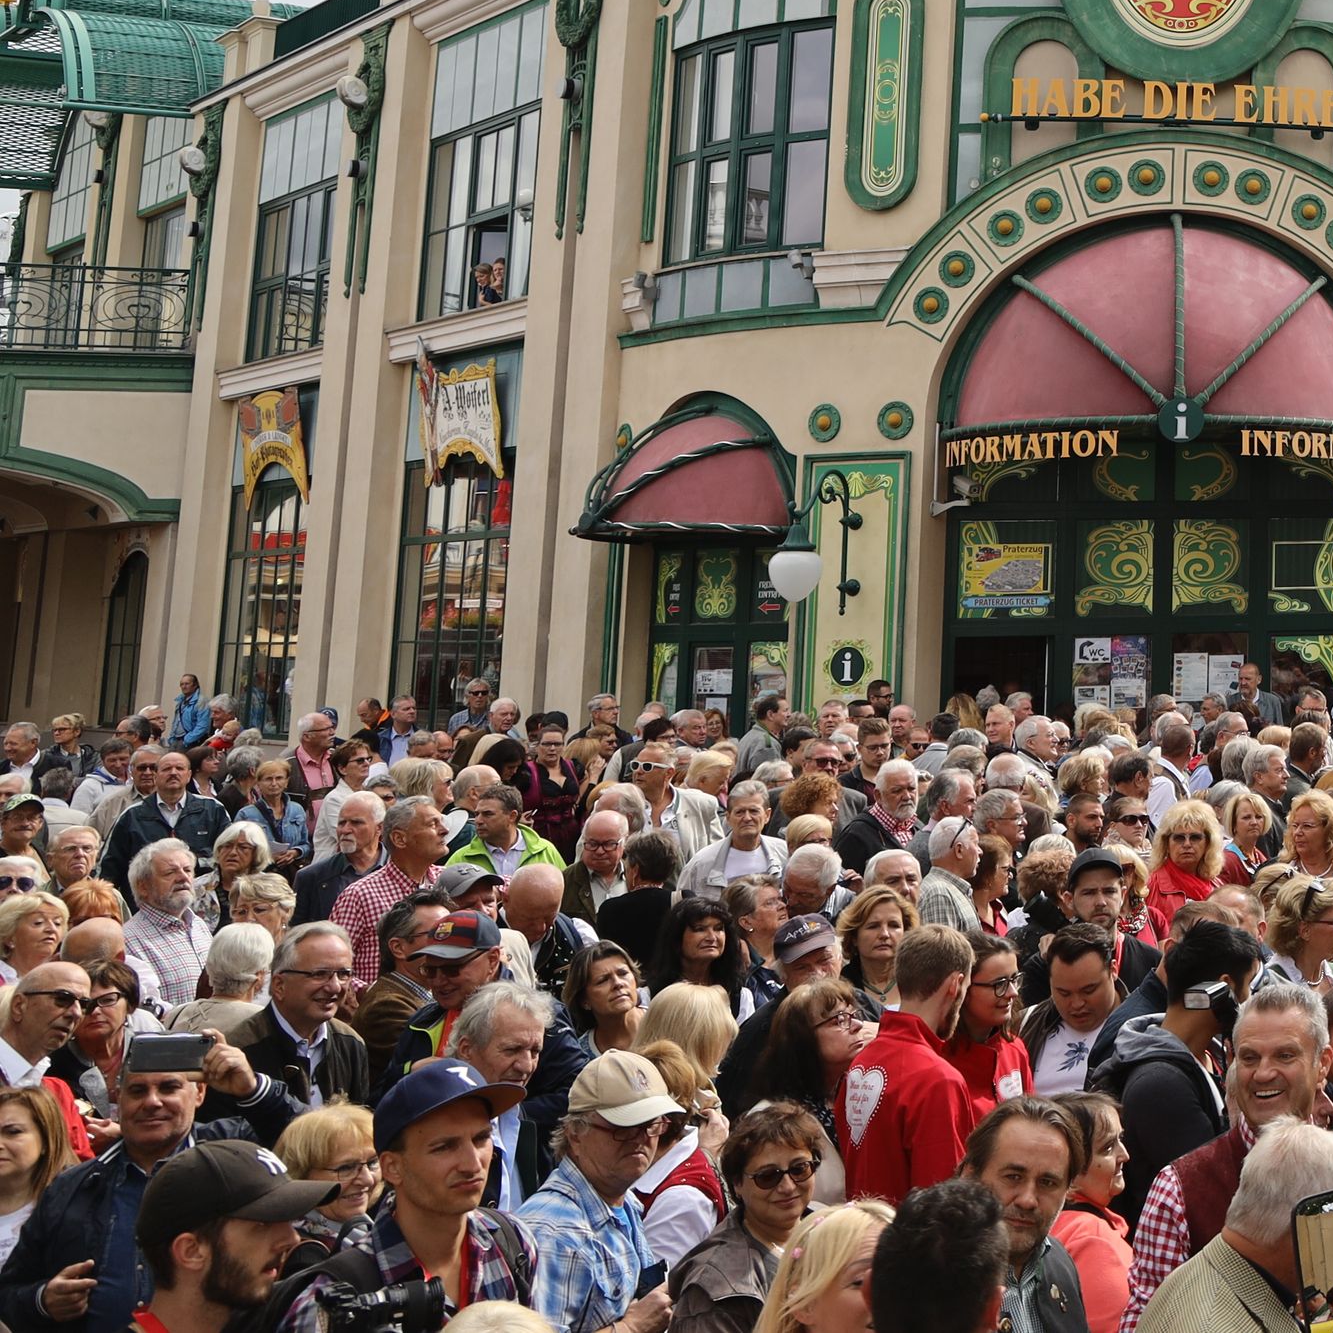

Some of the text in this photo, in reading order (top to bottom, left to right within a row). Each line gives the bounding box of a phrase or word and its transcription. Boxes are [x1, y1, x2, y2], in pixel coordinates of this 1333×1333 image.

[1010, 78, 1126, 119] HABE
[1142, 80, 1217, 121] DIE
[945, 429, 1119, 467] INFORMATION
[1002, 545, 1043, 554] Praterzug
[974, 597, 1038, 606] PRATERZUG TICKET
[1089, 648, 1105, 657] WC
